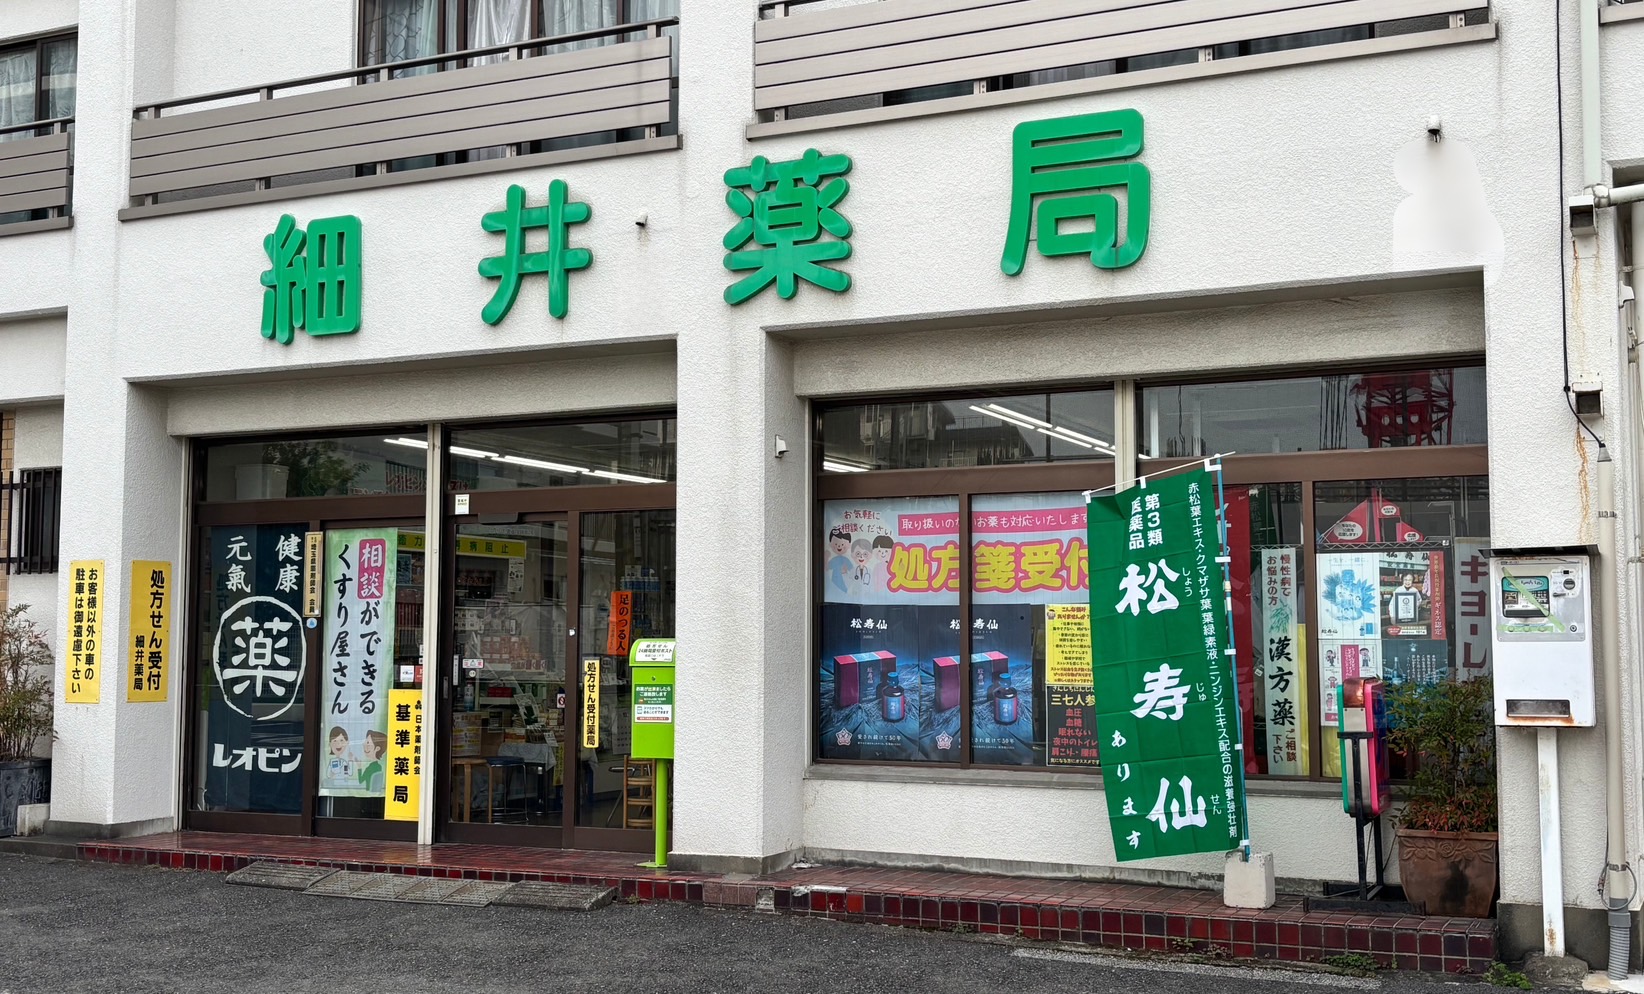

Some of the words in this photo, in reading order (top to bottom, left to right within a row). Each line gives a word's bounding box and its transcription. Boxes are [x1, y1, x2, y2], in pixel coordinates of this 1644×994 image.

[260, 107, 1151, 345] 細井薬局
[832, 522, 893, 536] ご相談ください
[843, 509, 881, 521] お気軽に
[1128, 496, 1145, 551] 医薬品
[225, 536, 252, 593] 元氣
[275, 534, 303, 592] 健康
[891, 541, 1089, 590] 処方箋受付
[1266, 555, 1279, 606] お悩みの方
[1279, 553, 1292, 596] 慢性病で
[71, 567, 86, 694] 駐車は御遠慮下さい
[84, 567, 98, 681] お客様以外の車の
[147, 569, 165, 692] 処方せん受付
[330, 543, 353, 717] くすり屋さん
[359, 542, 384, 716] 相談ができる
[615, 593, 629, 652] 足のつる人
[850, 617, 888, 630] 松寿仙
[950, 617, 999, 630] 松寿仙
[133, 634, 145, 691] 細井薬局
[222, 616, 298, 697] 薬
[1268, 635, 1297, 727] 漢方薬
[586, 662, 597, 746] 処方せん受付薬局
[1051, 694, 1096, 707] 三七人参
[1066, 708, 1082, 717] 血圧
[1115, 558, 1208, 834] 松寿仙
[1181, 567, 1193, 597] しょう
[1195, 682, 1207, 702] じゅ
[1209, 794, 1222, 815] せん
[212, 743, 302, 773] レオピン
[393, 703, 411, 804] 基準薬局
[413, 714, 422, 775] 日本薬剤師会
[1053, 737, 1098, 747] 夜中のトイレ
[1058, 728, 1091, 737] 眠れない
[1272, 733, 1284, 764] 下さい
[1285, 729, 1298, 763] ご相談
[1111, 729, 1142, 850] あります
